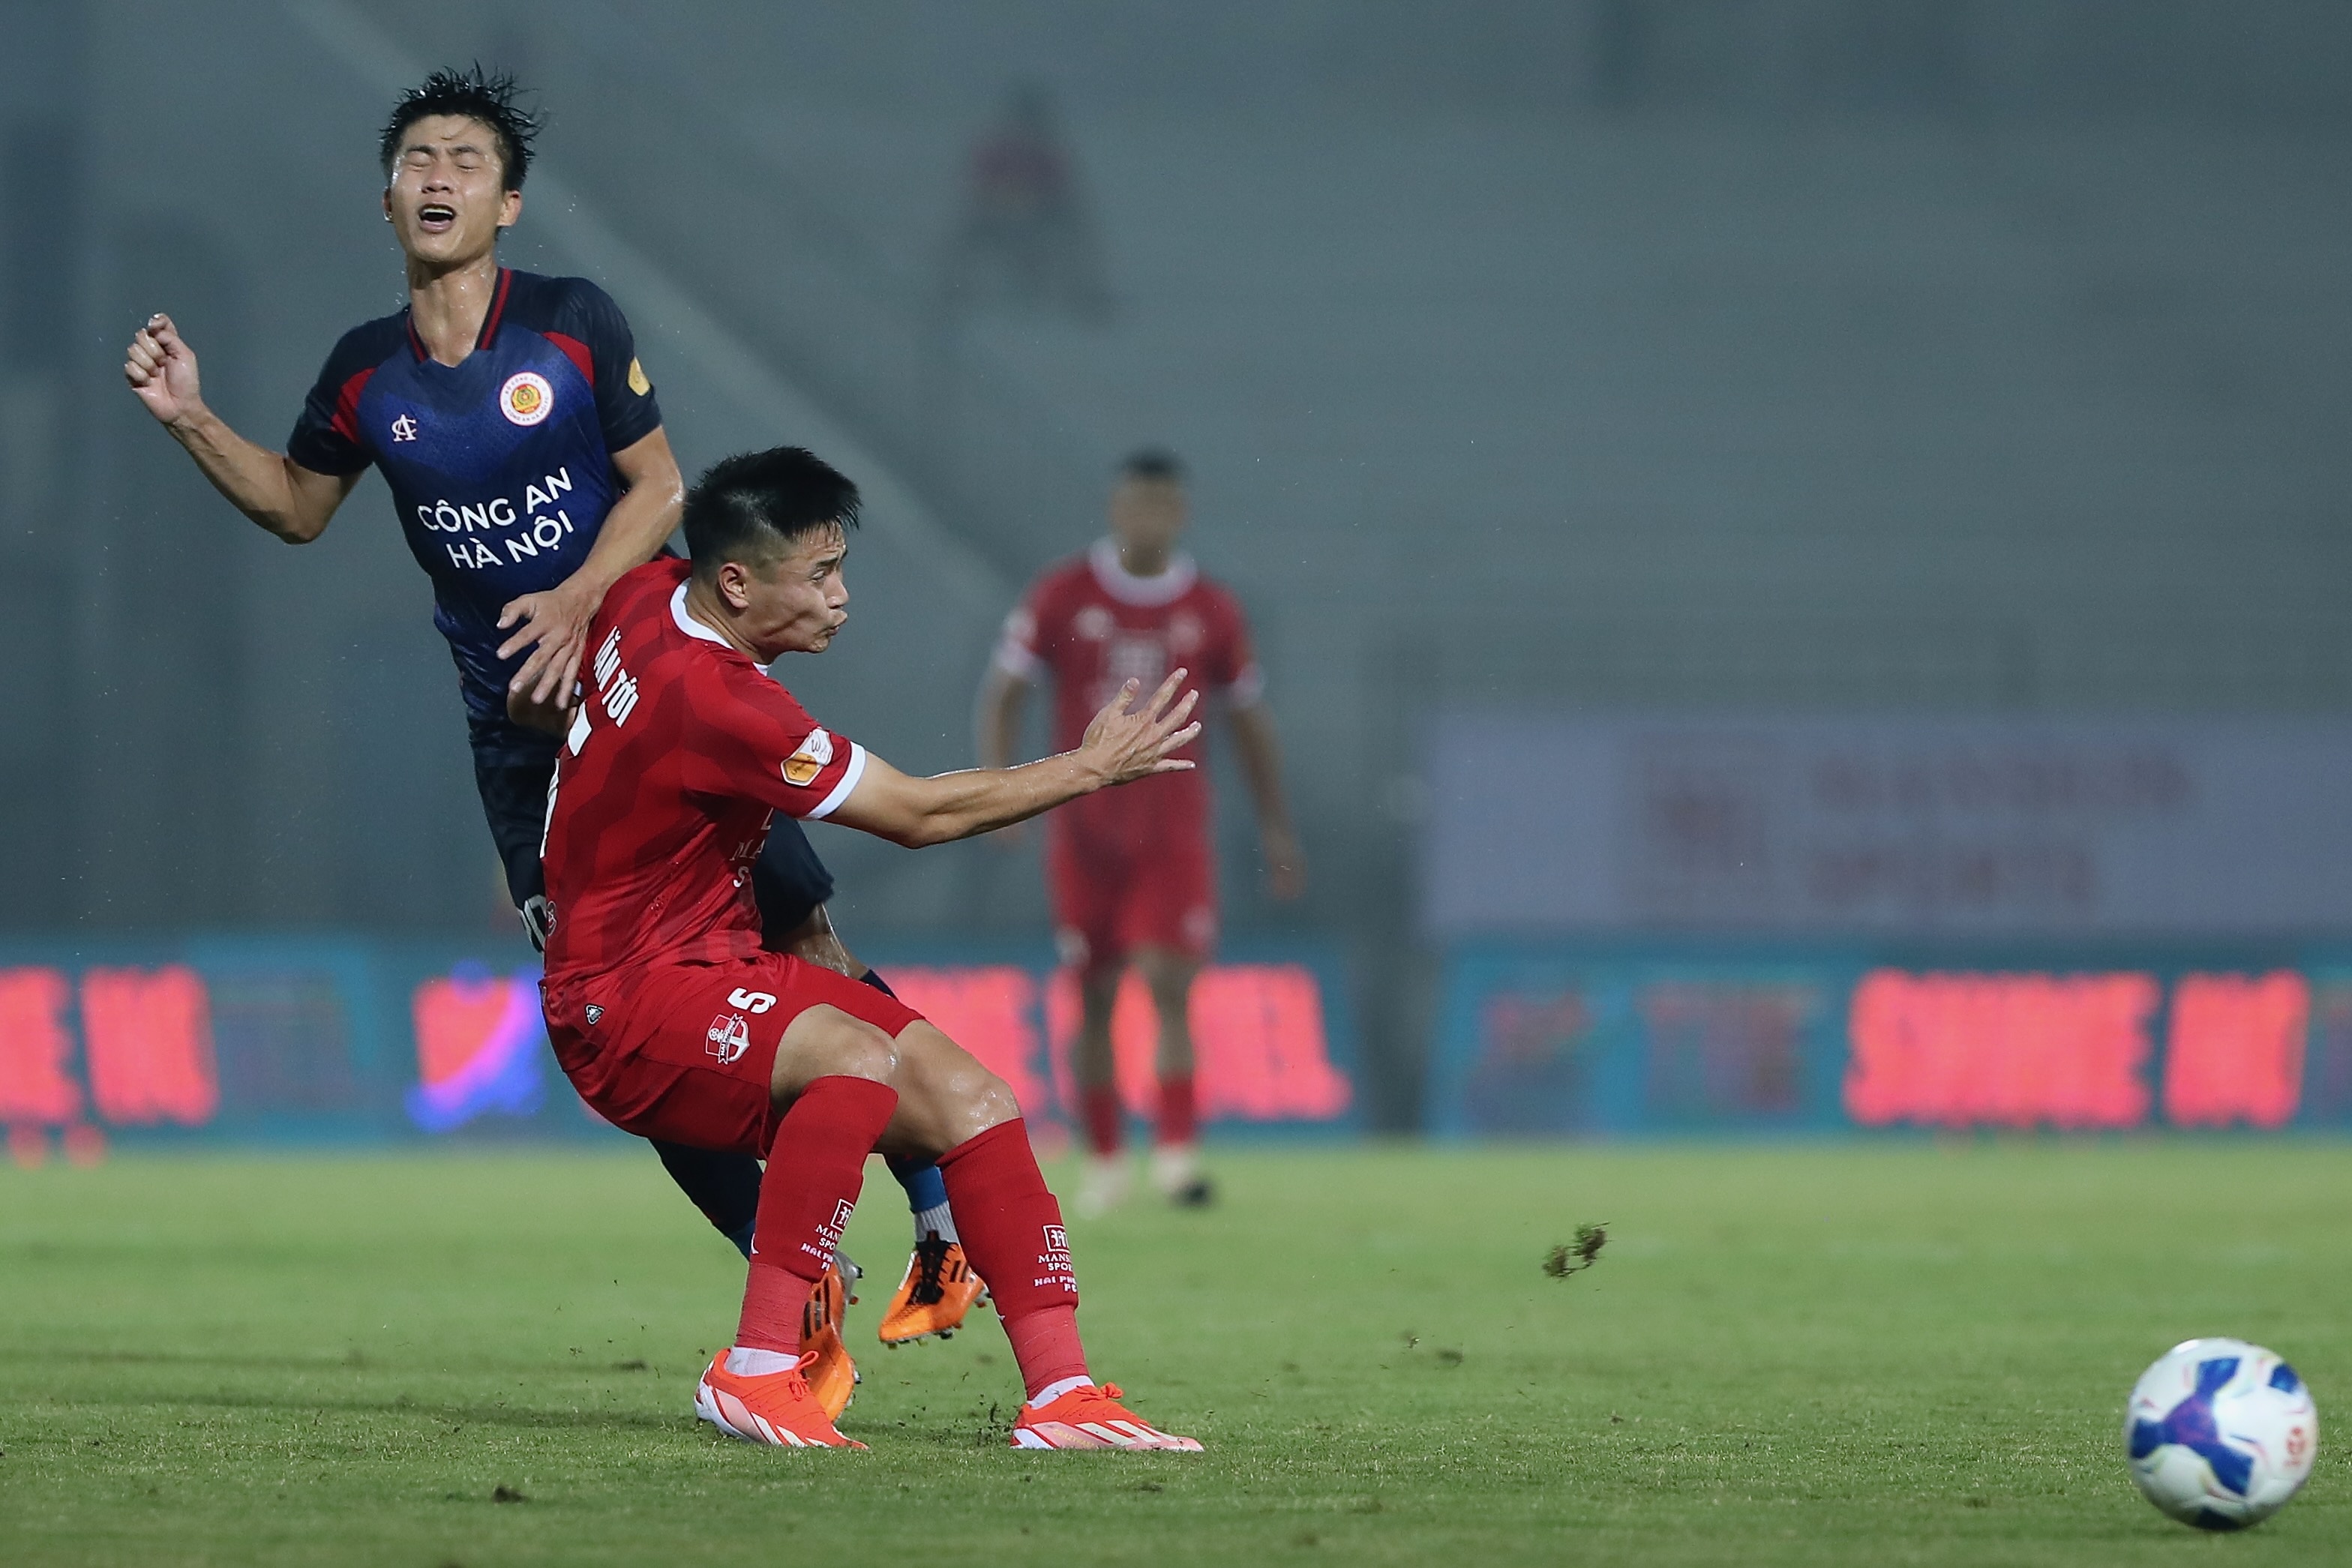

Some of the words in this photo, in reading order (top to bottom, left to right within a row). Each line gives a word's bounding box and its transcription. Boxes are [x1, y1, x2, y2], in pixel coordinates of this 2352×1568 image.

[417, 499, 517, 532] CÔNG
[526, 466, 572, 515] AN
[446, 537, 504, 569] HÀ
[504, 509, 574, 563] NỘI
[602, 668, 640, 728] TỚI
[1034, 1276, 1056, 1287] HAI
